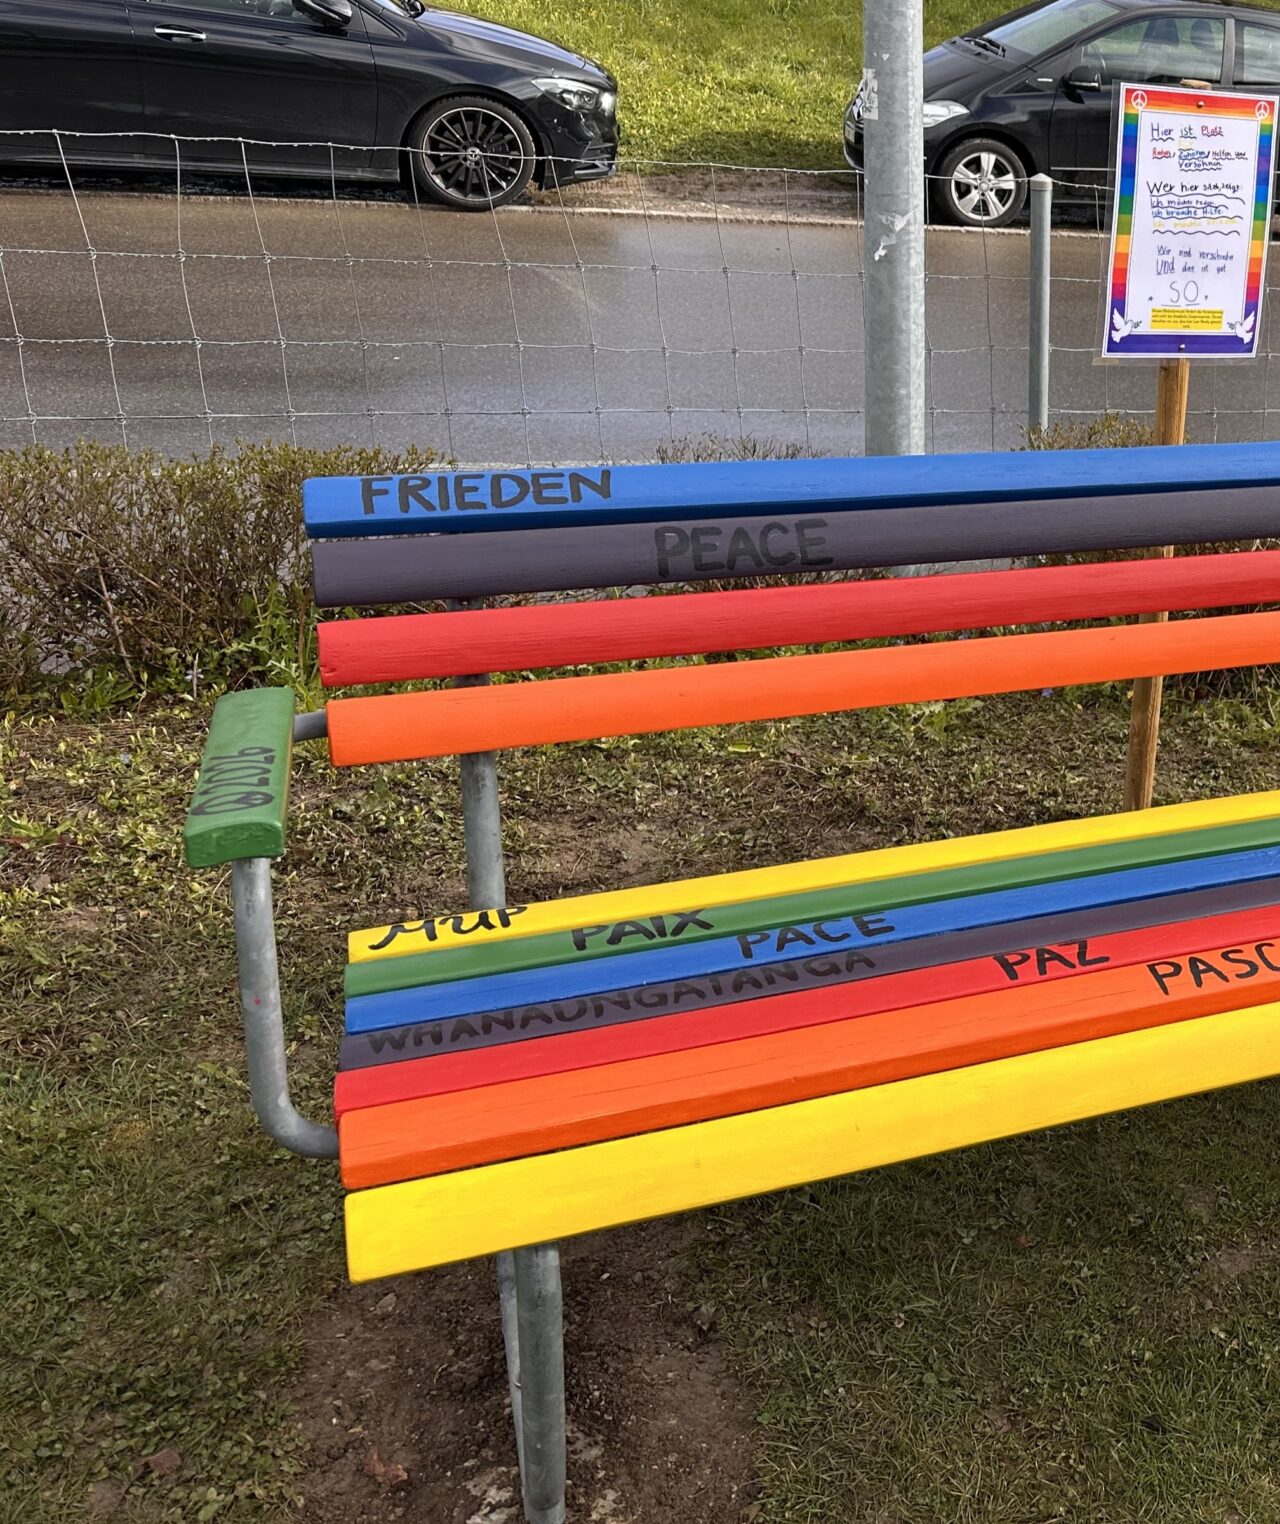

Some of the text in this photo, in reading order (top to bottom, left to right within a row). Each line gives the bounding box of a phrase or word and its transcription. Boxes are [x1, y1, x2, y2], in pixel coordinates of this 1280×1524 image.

[1151, 122, 1223, 138] Hier ist Platz
[1146, 180, 1176, 195] Wer
[1180, 181, 1200, 193] hier
[359, 469, 612, 515] FRIEDEN
[653, 518, 835, 578] PEACE
[570, 908, 715, 951] PAIX
[736, 910, 896, 959] PACE
[993, 939, 1110, 981] PAZ
[366, 950, 877, 1055] WHANAUNGATANGA
